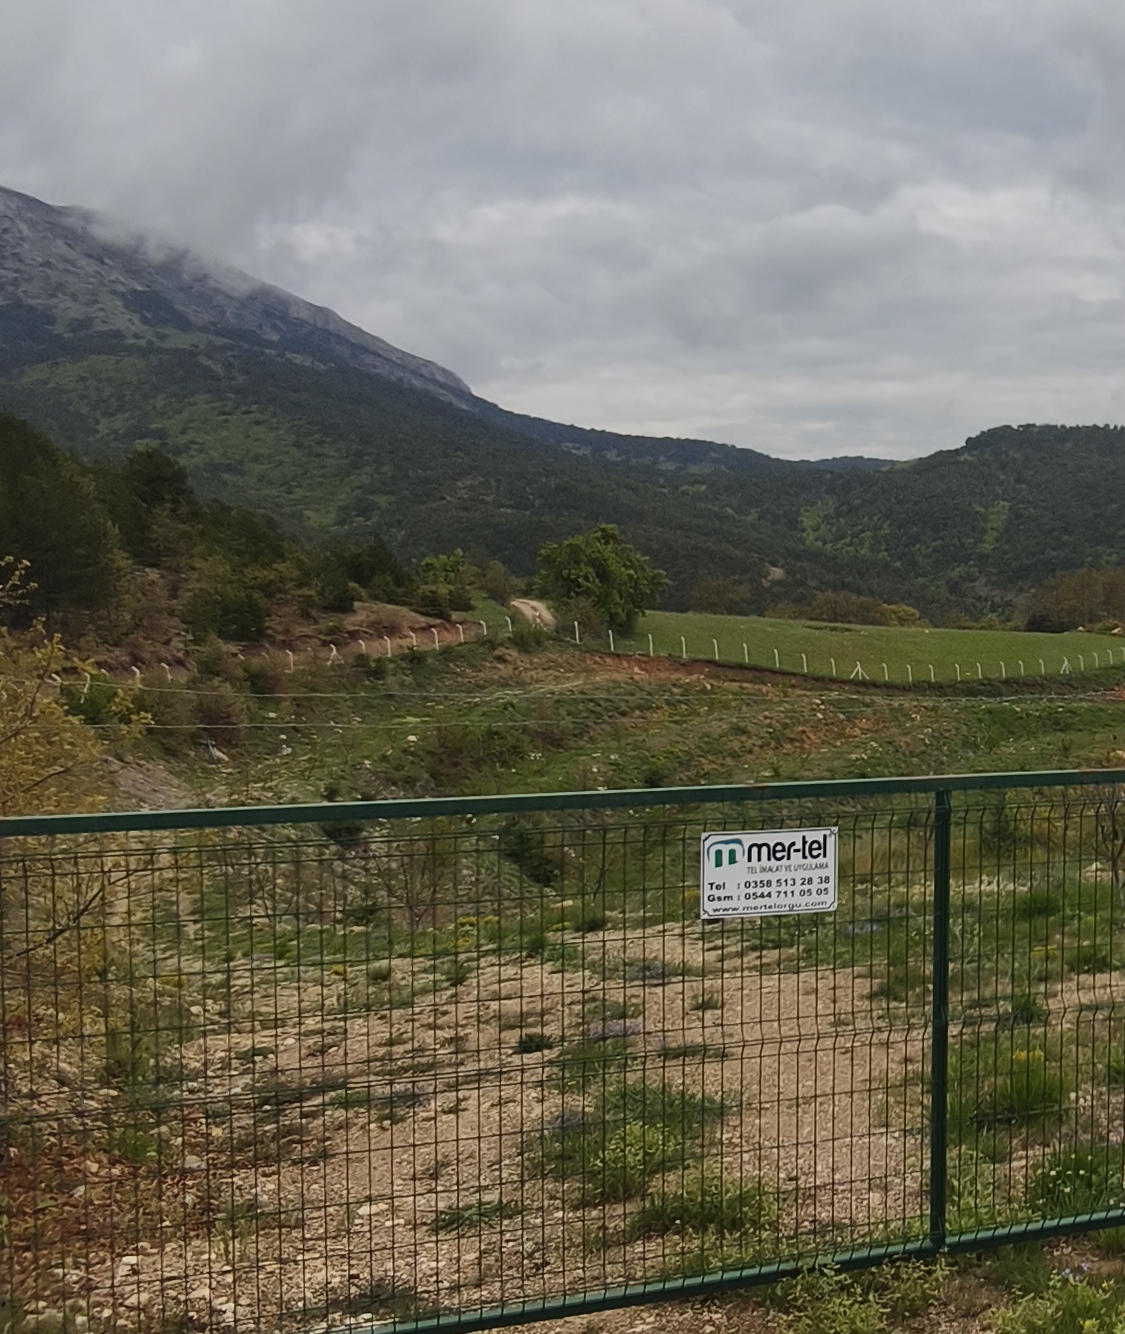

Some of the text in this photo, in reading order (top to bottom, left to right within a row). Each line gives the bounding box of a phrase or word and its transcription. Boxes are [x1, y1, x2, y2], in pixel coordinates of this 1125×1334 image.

[747, 834, 827, 862] mer-tel
[747, 866, 758, 874] TEL
[708, 882, 726, 891] Tel
[744, 879, 772, 889] 0358
[776, 878, 796, 887] 513
[800, 877, 813, 886] 28
[817, 875, 830, 885] 38
[707, 894, 733, 902] Gsm
[744, 891, 772, 900] 0544
[775, 890, 795, 899] 711
[799, 889, 813, 897] 05
[816, 887, 829, 896] 05
[712, 900, 827, 913] www.mertelorgu.com
